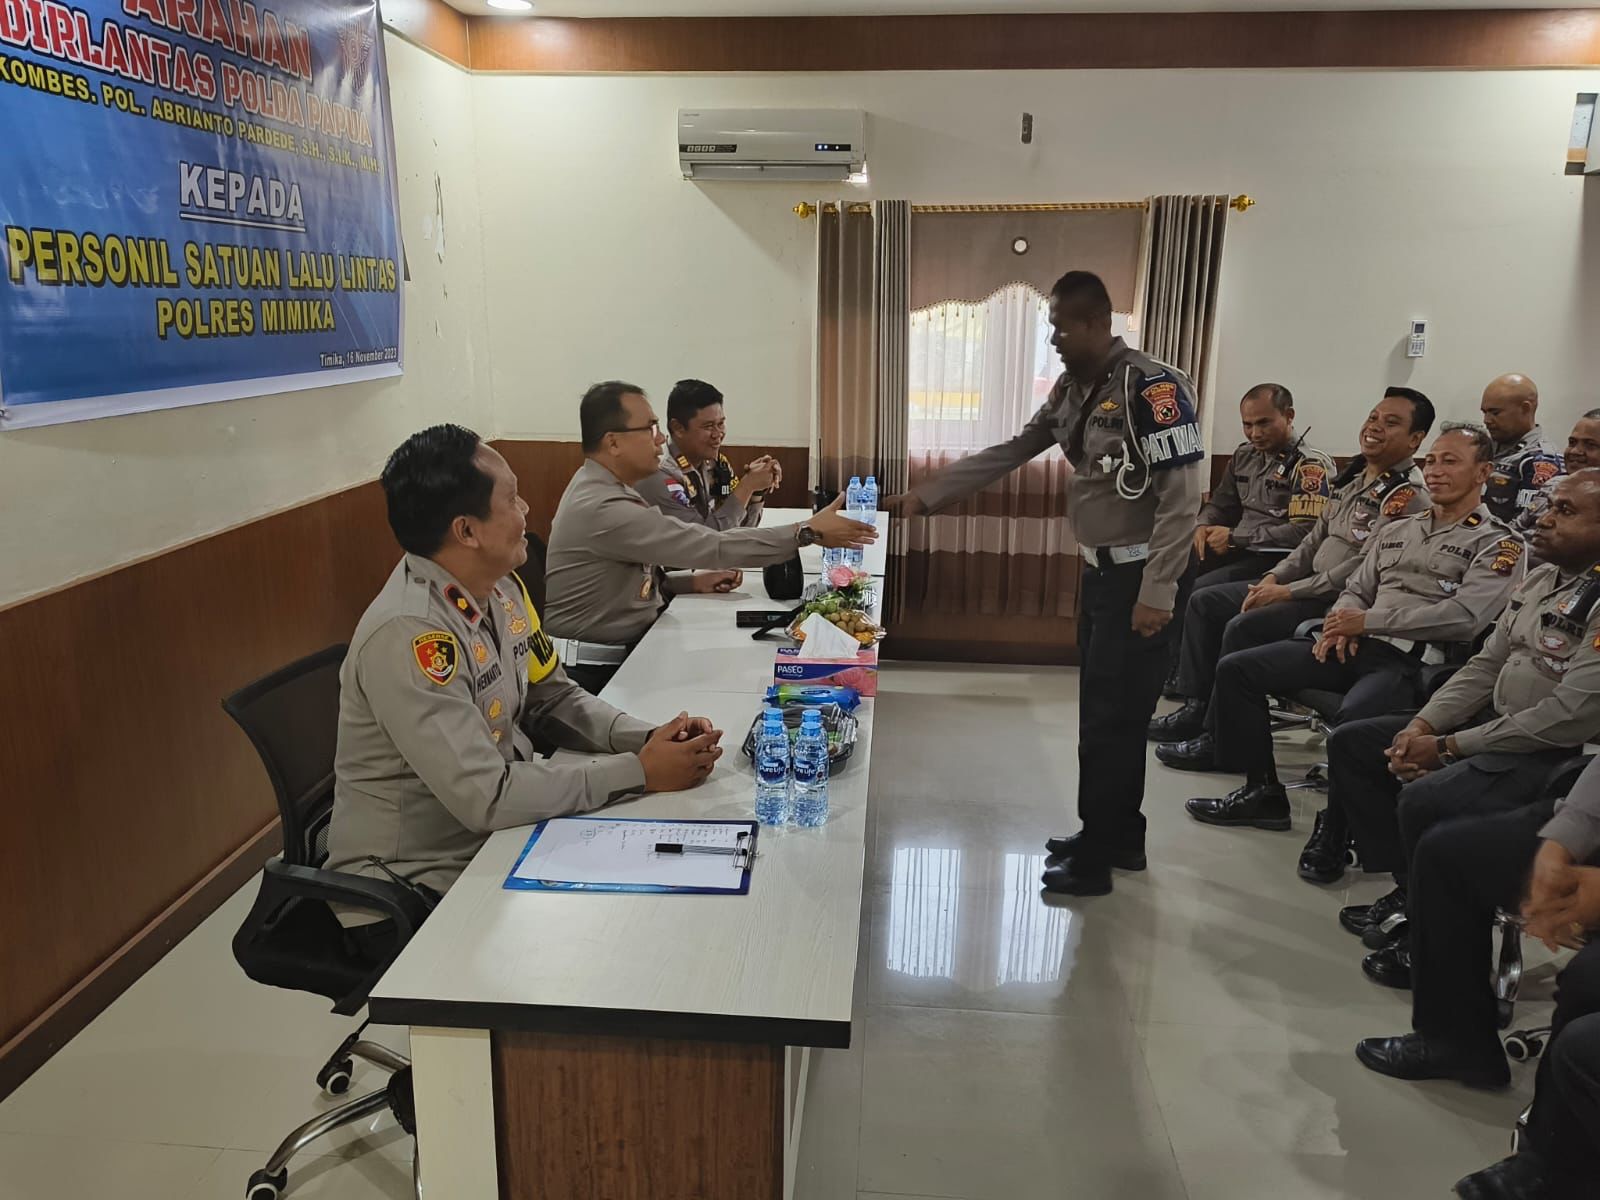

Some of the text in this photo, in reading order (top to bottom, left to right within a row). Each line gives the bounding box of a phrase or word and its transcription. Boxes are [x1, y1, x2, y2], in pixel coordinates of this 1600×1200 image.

[0, 0, 374, 147] DIRLANTAS POLDA PAPUA
[103, 84, 145, 115] POL.
[152, 100, 233, 137] ABRIANTO
[238, 121, 299, 154] PARDEDE,
[180, 161, 304, 220] KEPADA
[6, 226, 397, 292] PERSONIL SATUAN LALU LINTAS
[157, 298, 336, 339] POLRES MIMIKA
[320, 347, 397, 368] Timika, 16 November 2023
[777, 665, 804, 674] PASEO
